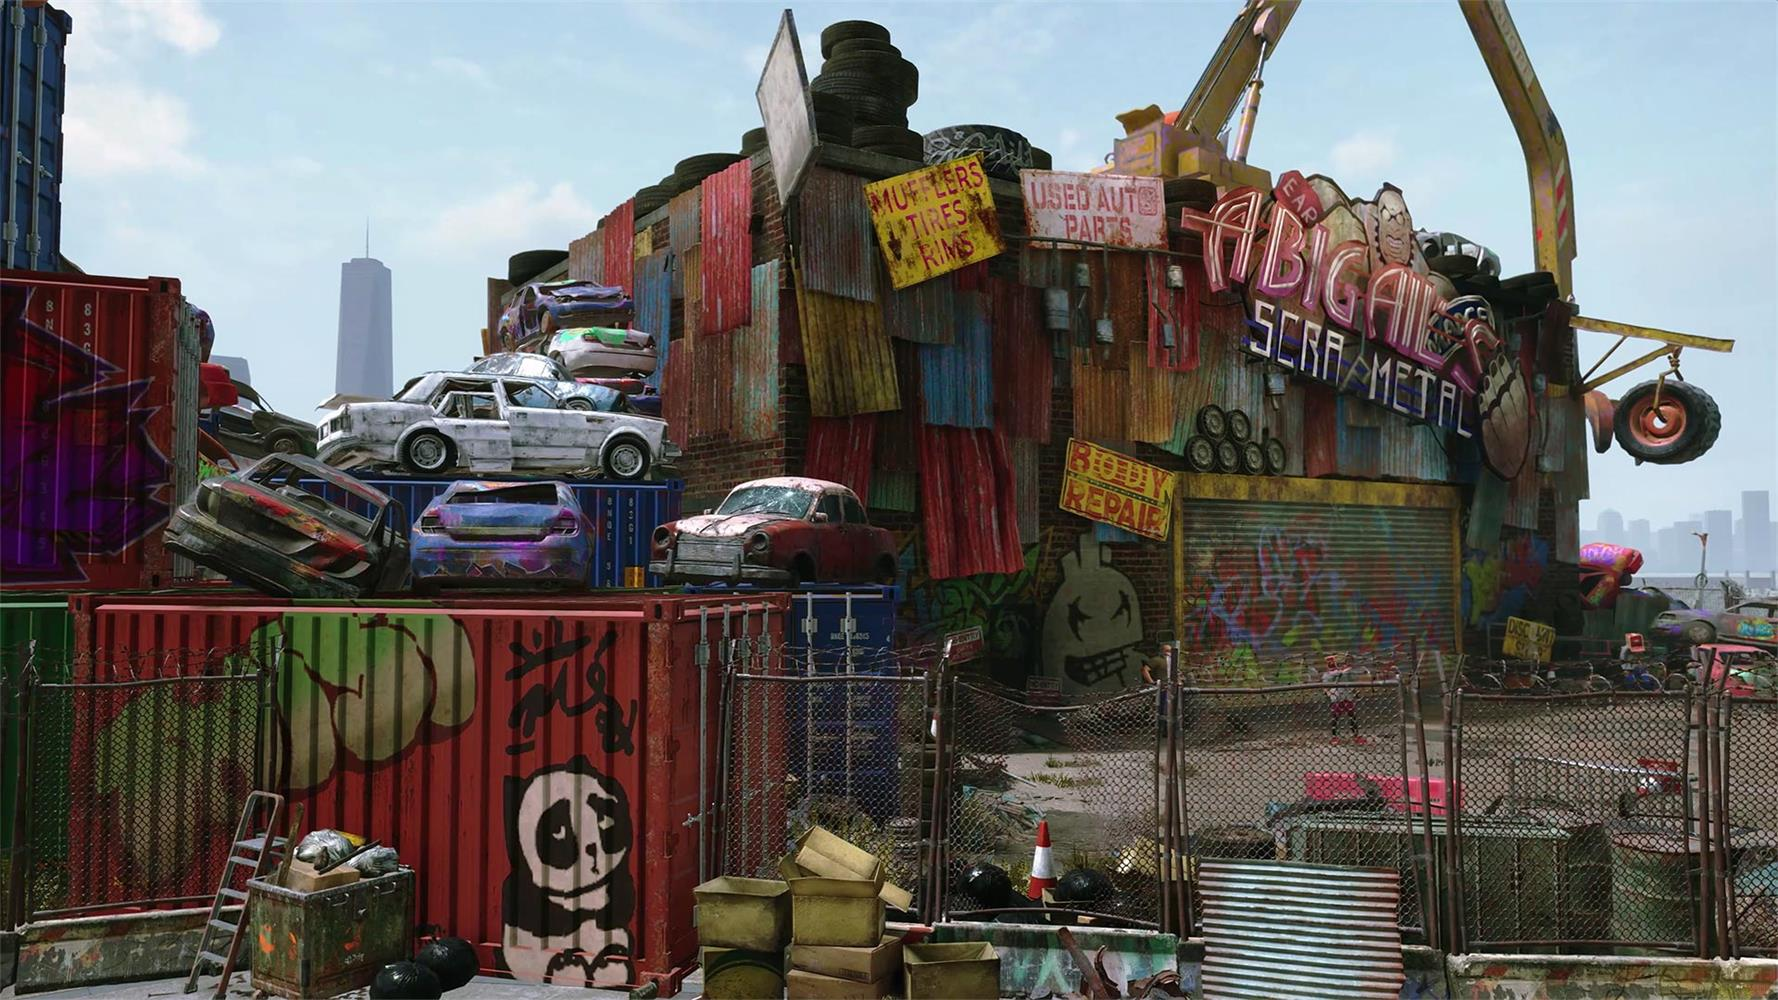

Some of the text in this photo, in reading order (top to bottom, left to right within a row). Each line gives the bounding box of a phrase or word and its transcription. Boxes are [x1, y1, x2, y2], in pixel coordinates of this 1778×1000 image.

[871, 160, 985, 217] MUFFLERS
[1031, 181, 1090, 212] USED
[905, 200, 968, 242] TIRES
[1064, 214, 1133, 244] PARTS
[921, 230, 976, 271] RIMS
[1368, 352, 1473, 439] METAL
[1070, 442, 1169, 498] BODY
[1064, 478, 1164, 532] REPAIR
